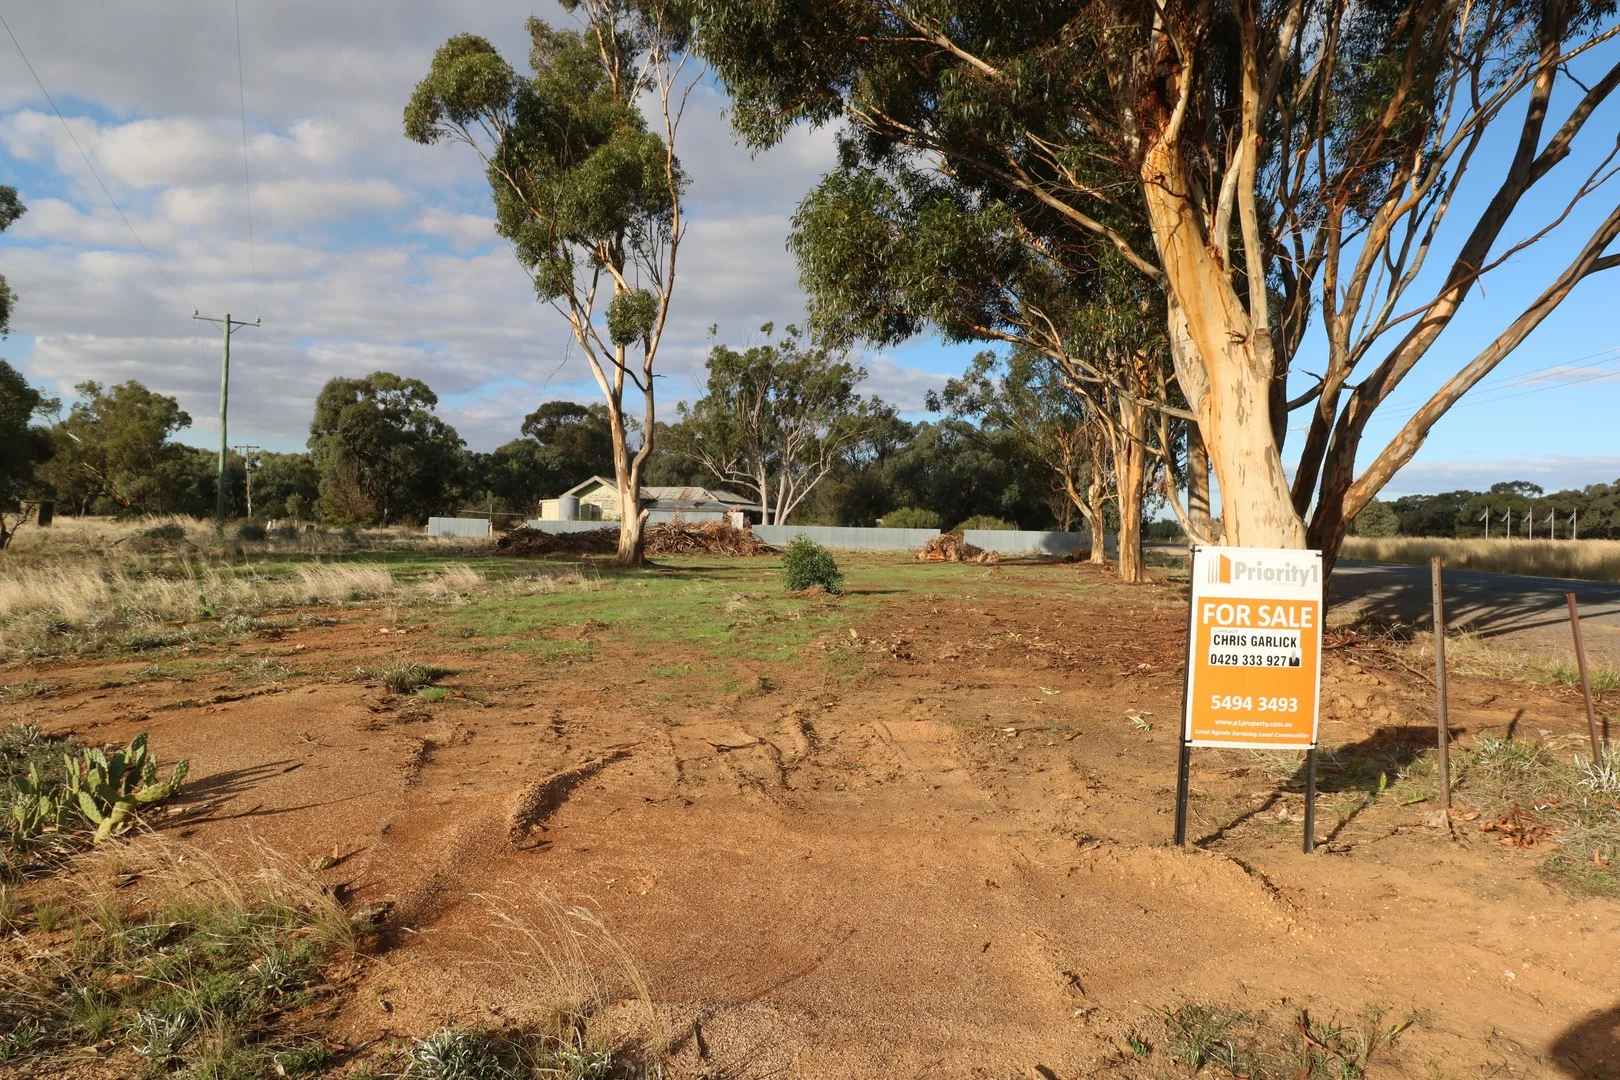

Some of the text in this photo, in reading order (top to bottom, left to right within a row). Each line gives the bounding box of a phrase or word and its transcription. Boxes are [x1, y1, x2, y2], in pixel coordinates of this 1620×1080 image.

[1234, 561, 1318, 587] Priority1
[1203, 603, 1313, 628] FOR SALE
[1213, 634, 1297, 648] CHRIS GARLICK
[1210, 654, 1287, 666] 0429 333 927
[1210, 695, 1298, 712] 5494 3493
[1214, 719, 1293, 728] www.p1property.com.au
